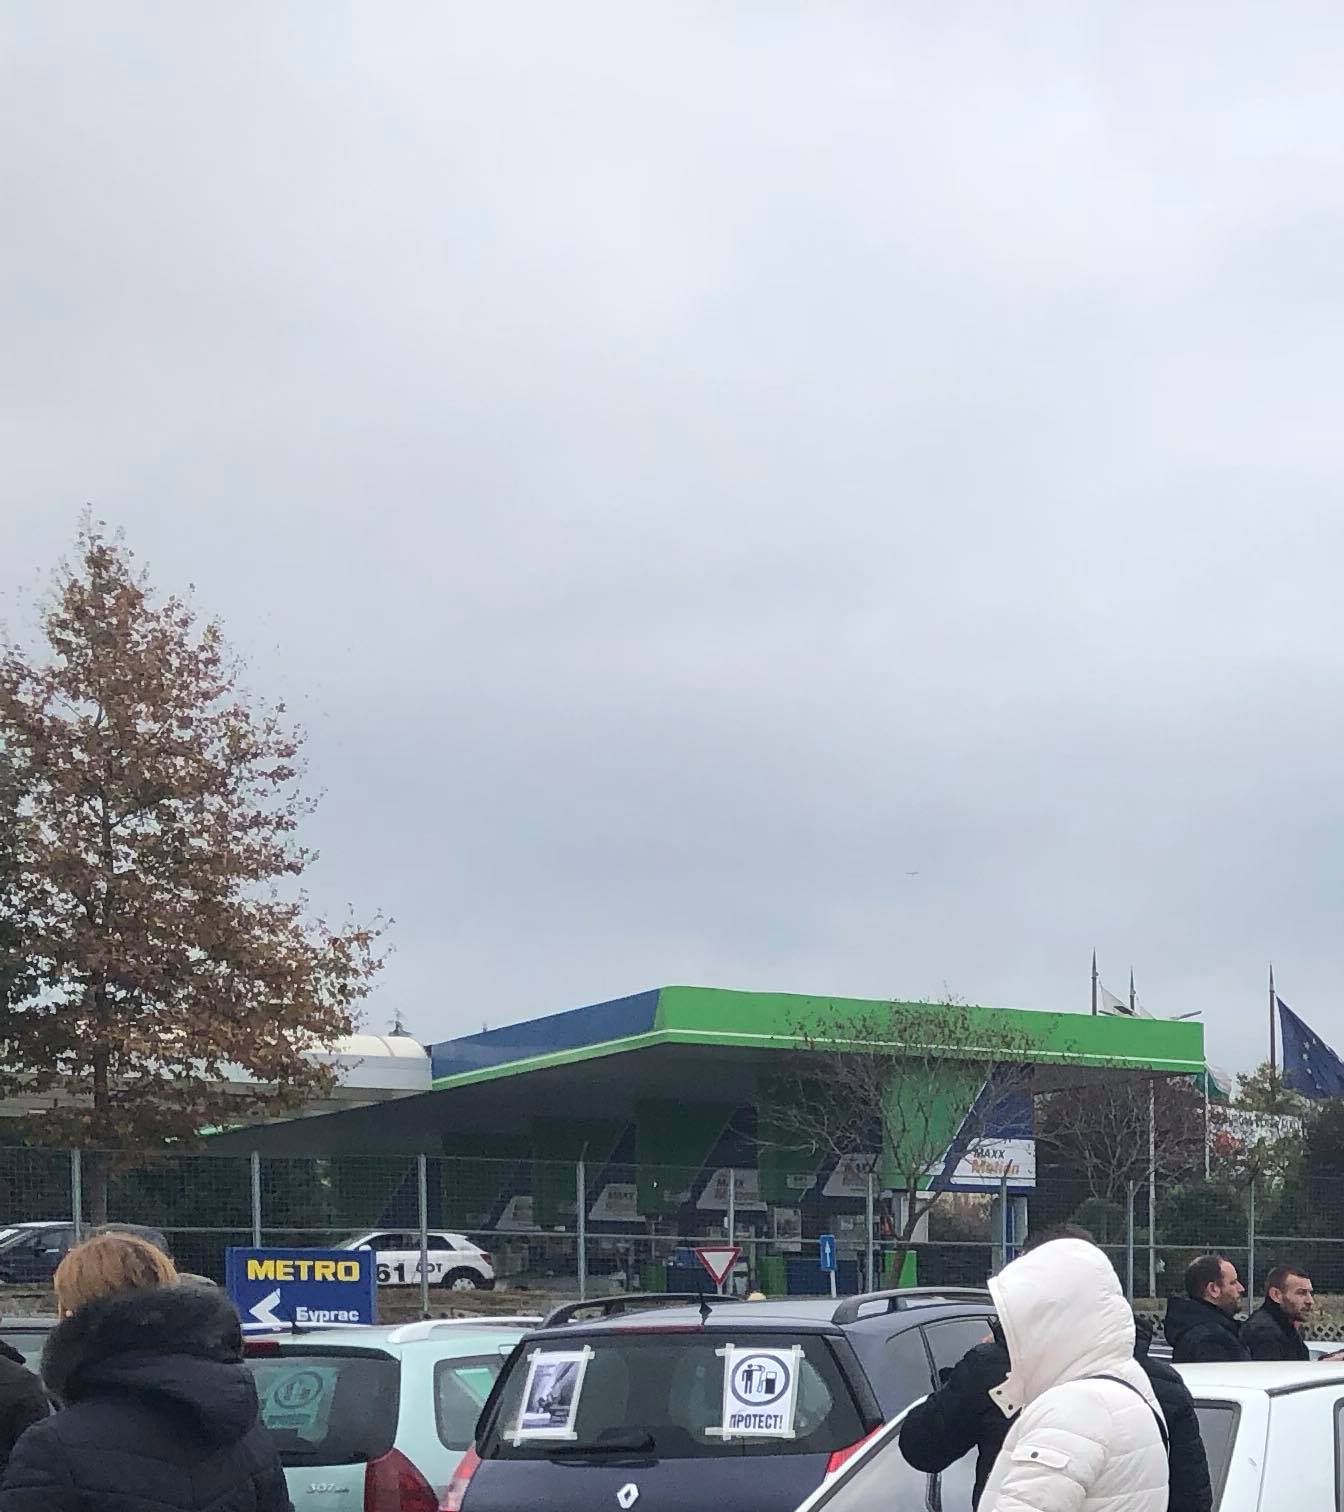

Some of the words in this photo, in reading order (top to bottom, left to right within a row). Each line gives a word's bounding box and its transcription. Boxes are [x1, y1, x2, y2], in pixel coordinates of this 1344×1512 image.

[247, 1260, 360, 1281] METRO
[296, 1306, 360, 1323] Бургас
[729, 1414, 783, 1429] ПРОТЕСТ!
